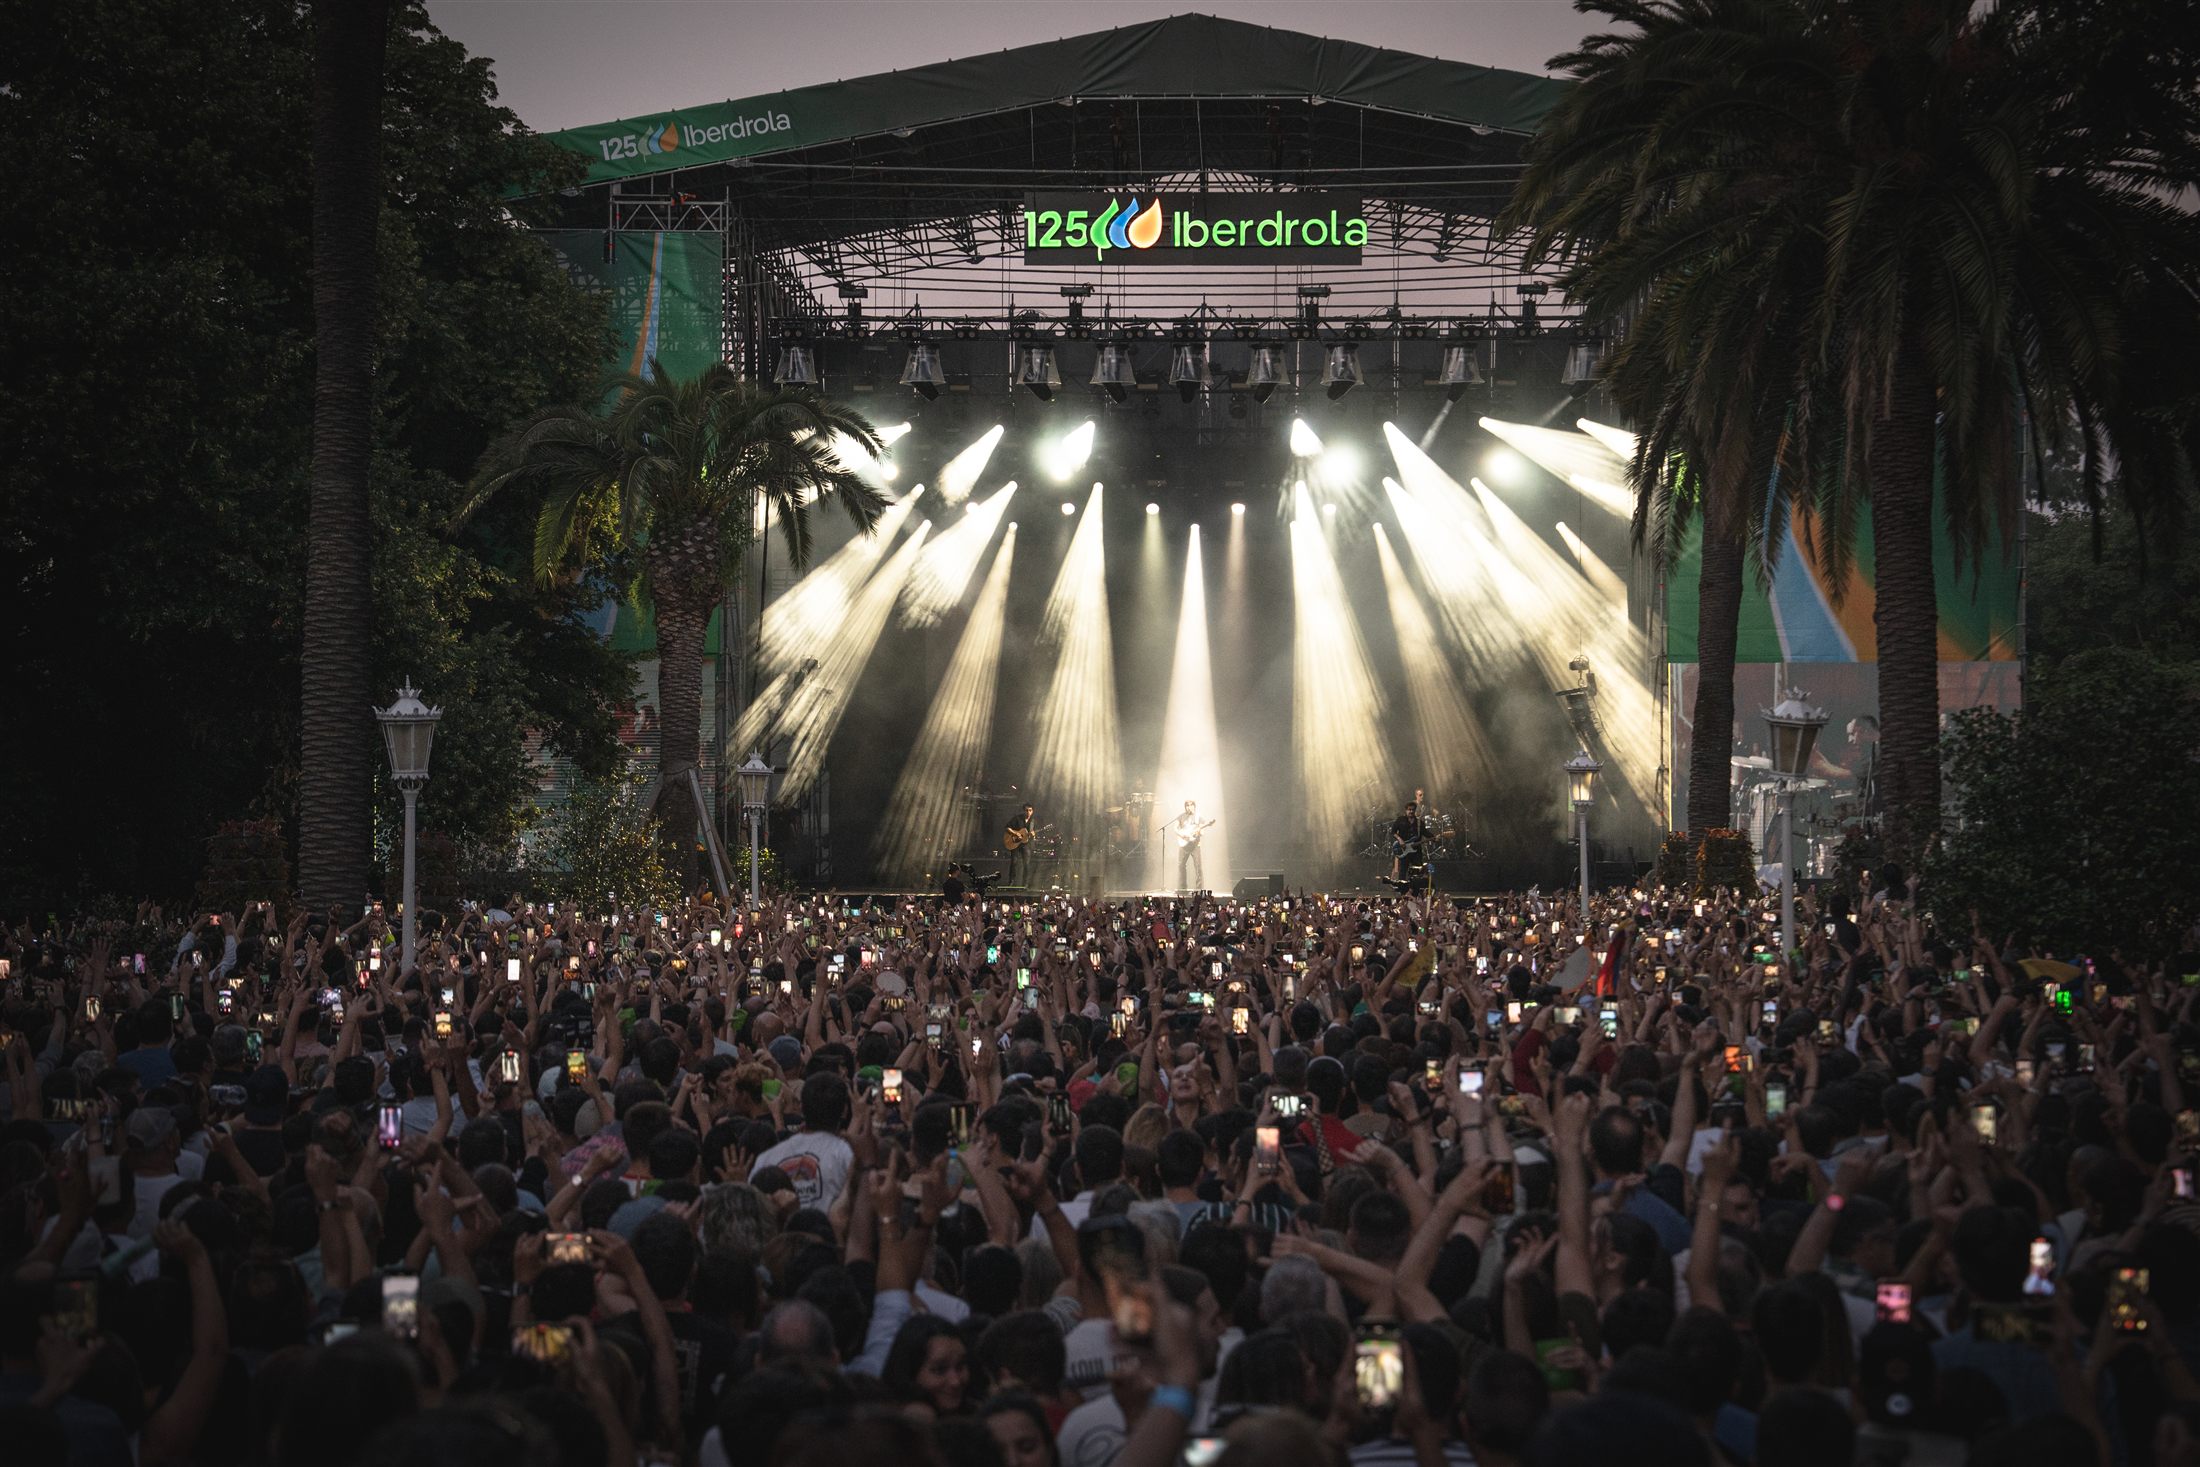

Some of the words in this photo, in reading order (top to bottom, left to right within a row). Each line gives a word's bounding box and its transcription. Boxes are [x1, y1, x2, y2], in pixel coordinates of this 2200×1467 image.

[600, 135, 638, 161] 125
[683, 110, 791, 147] Iberdrola
[1024, 211, 1088, 247] 125
[1173, 210, 1368, 247] Iberdrola
